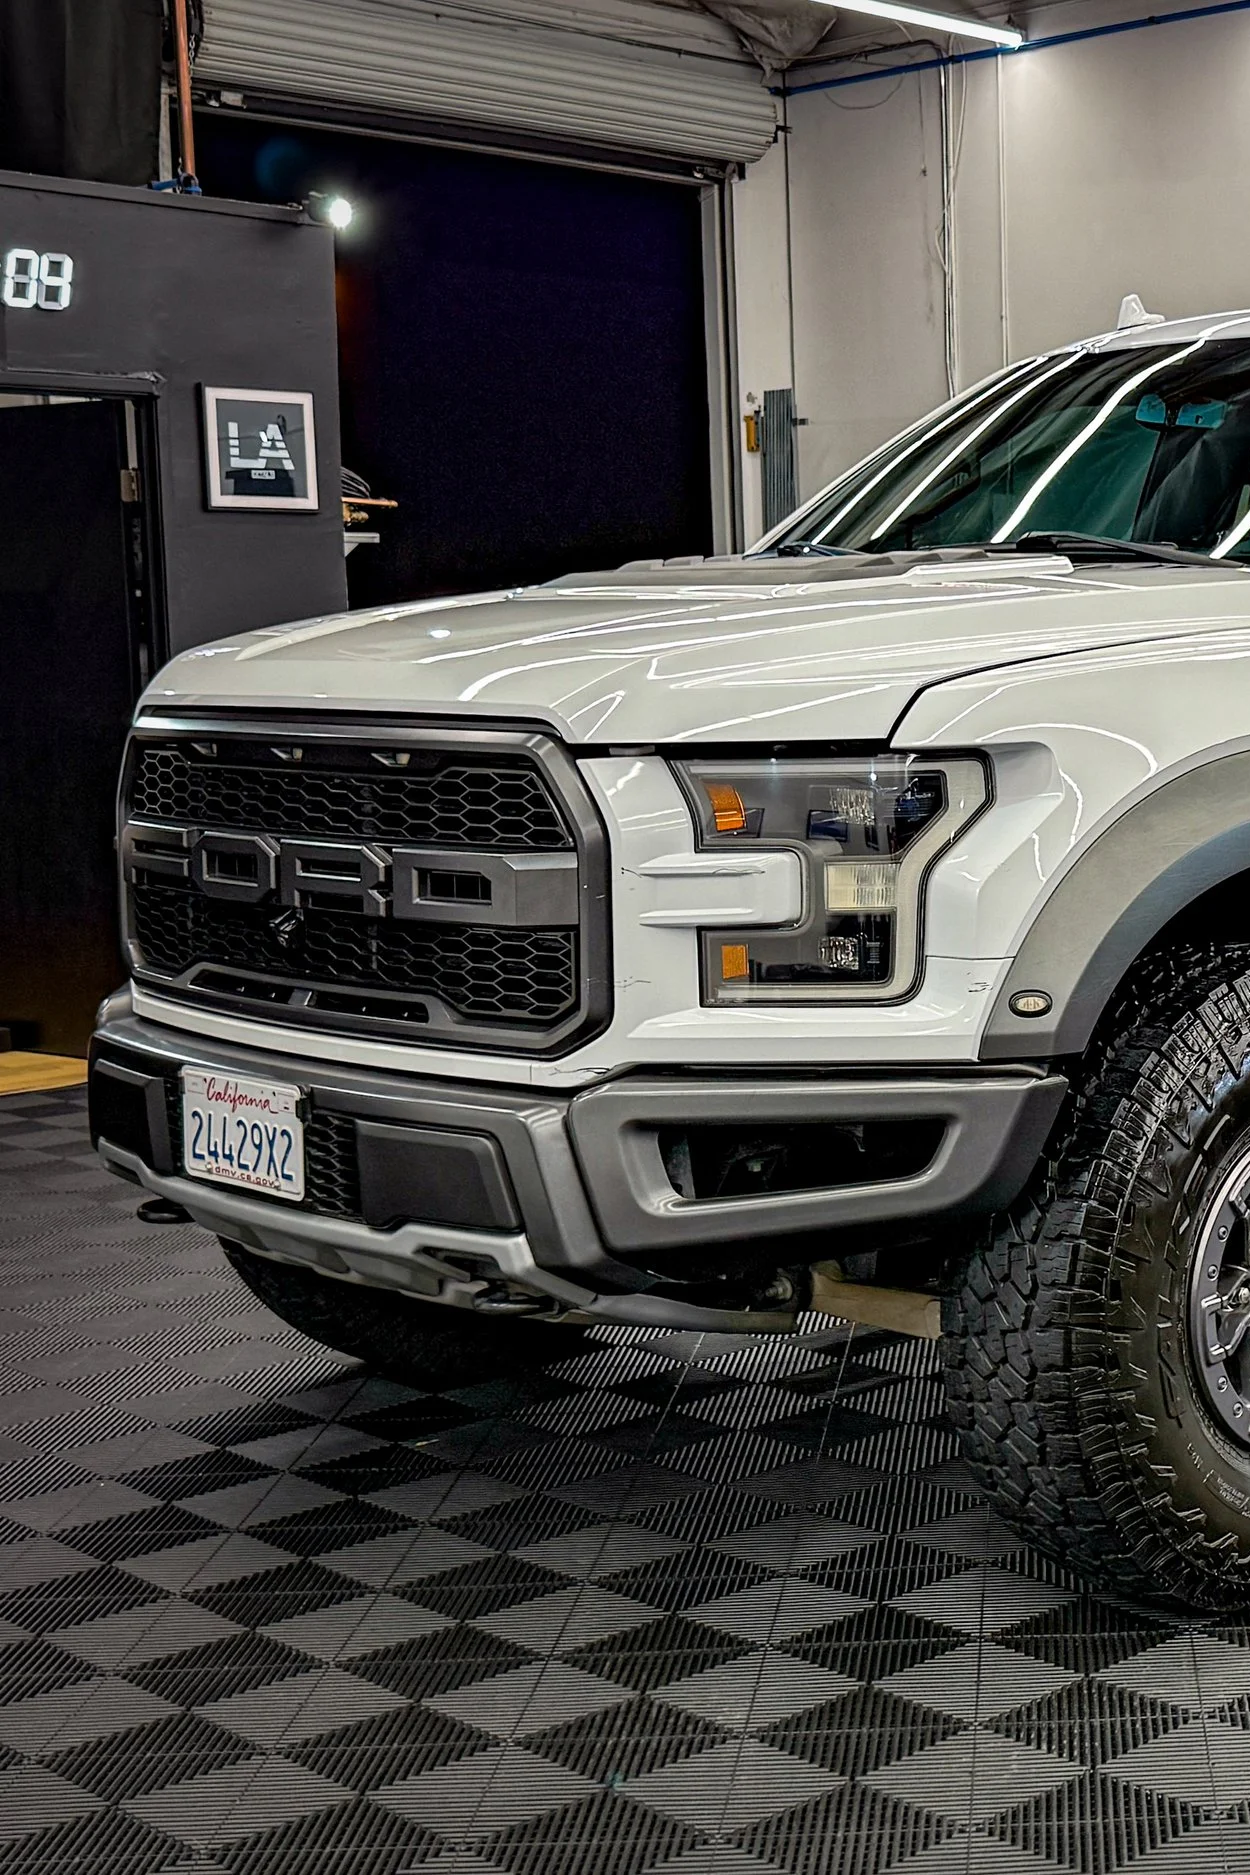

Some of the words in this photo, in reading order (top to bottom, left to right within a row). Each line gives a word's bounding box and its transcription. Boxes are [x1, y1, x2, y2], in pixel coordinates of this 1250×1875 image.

[4, 248, 74, 311] 09
[228, 421, 295, 471] LA
[125, 820, 578, 926] FORD
[205, 1077, 279, 1114] California
[192, 1110, 294, 1181] 24429X2
